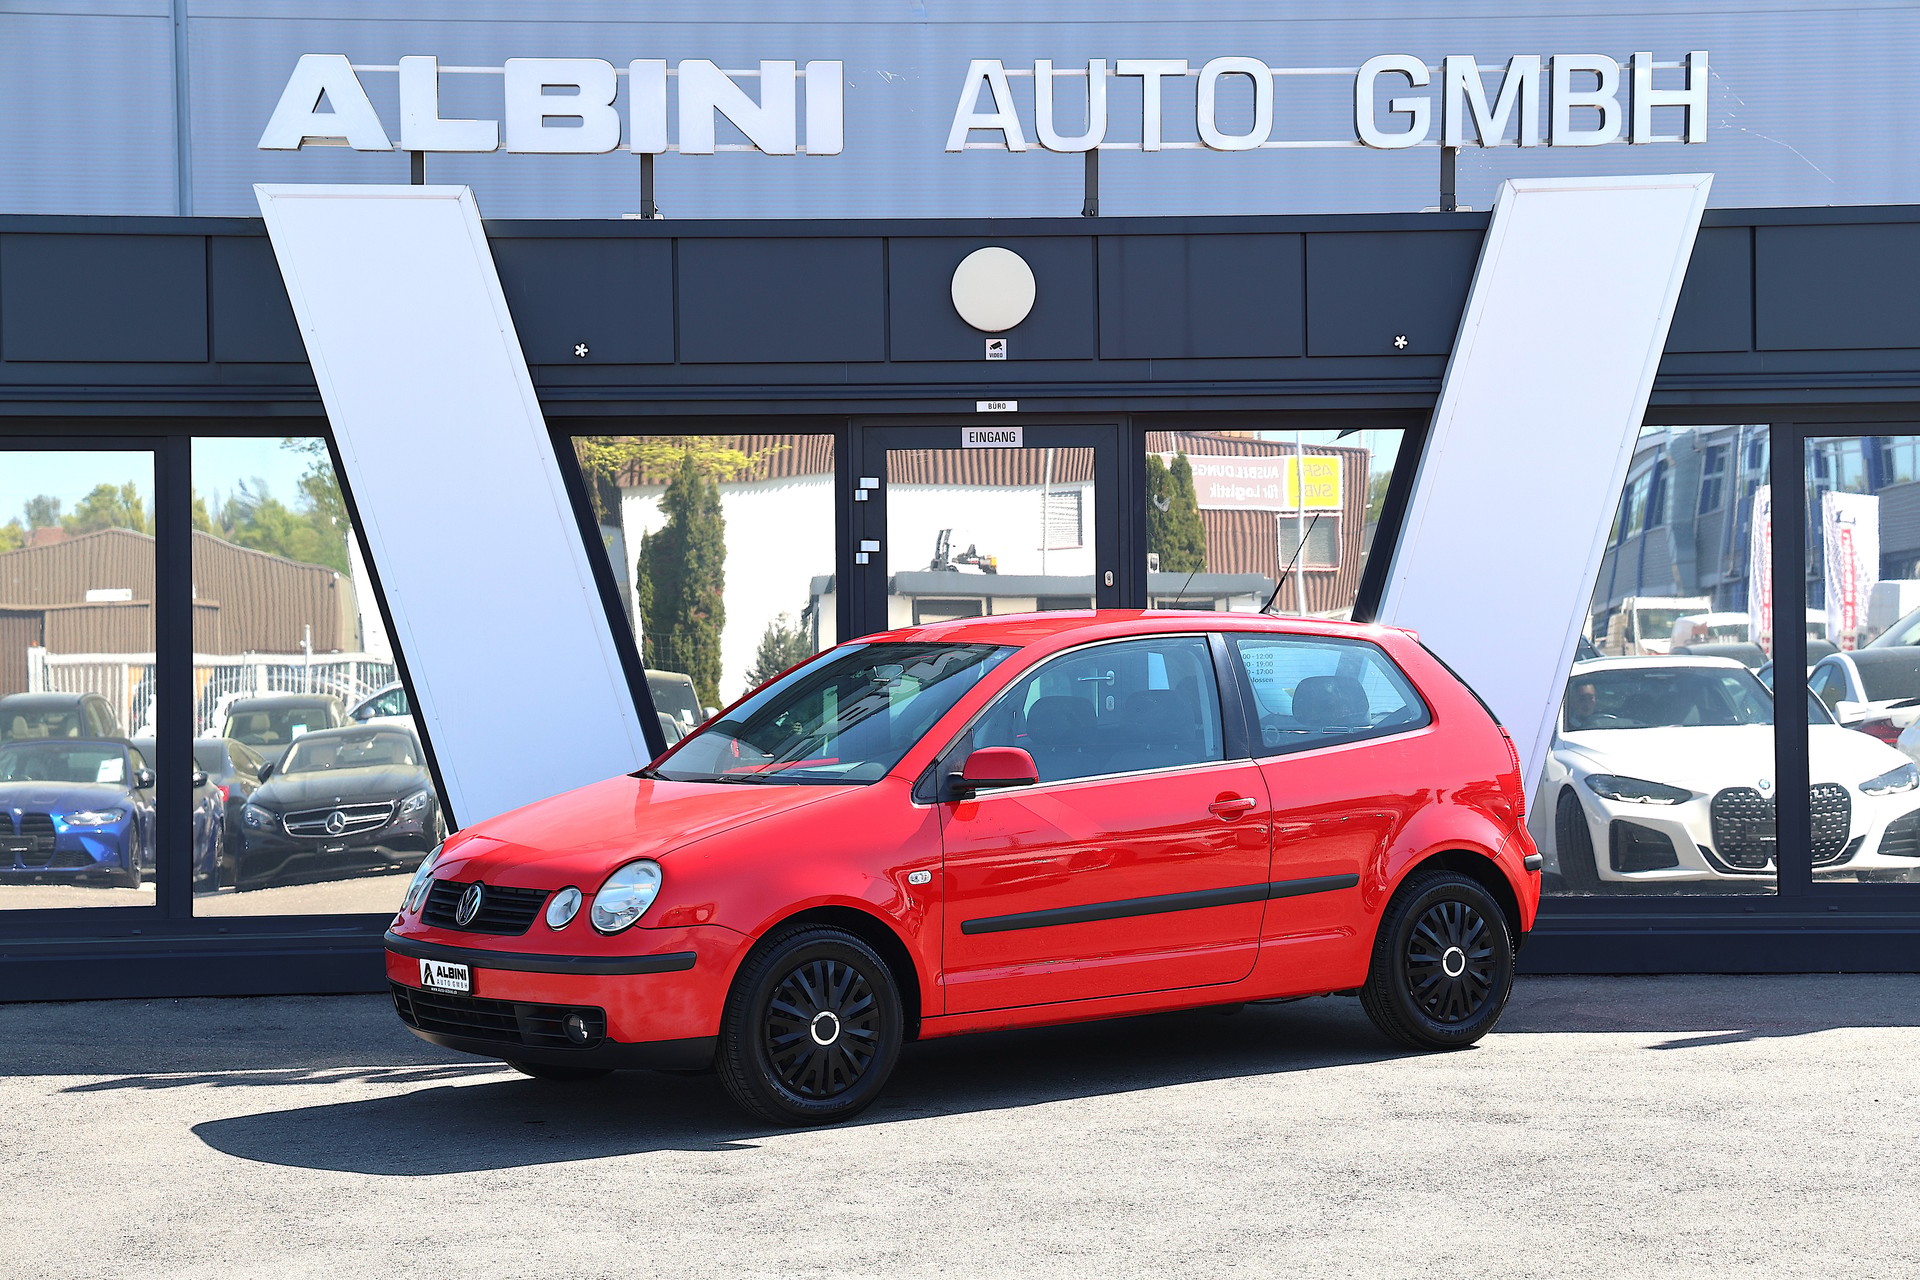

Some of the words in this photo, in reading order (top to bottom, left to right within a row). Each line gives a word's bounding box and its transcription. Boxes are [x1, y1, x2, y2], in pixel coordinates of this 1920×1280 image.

[258, 53, 844, 155] ALBINI
[944, 55, 1275, 152] AUTO
[1355, 50, 1709, 149] GMBH
[988, 402, 1006, 410] BÜRO
[969, 431, 1016, 443] EINGANG
[436, 965, 467, 981] ALBINI
[437, 978, 451, 987] AUTO
[452, 980, 468, 989] GMBH
